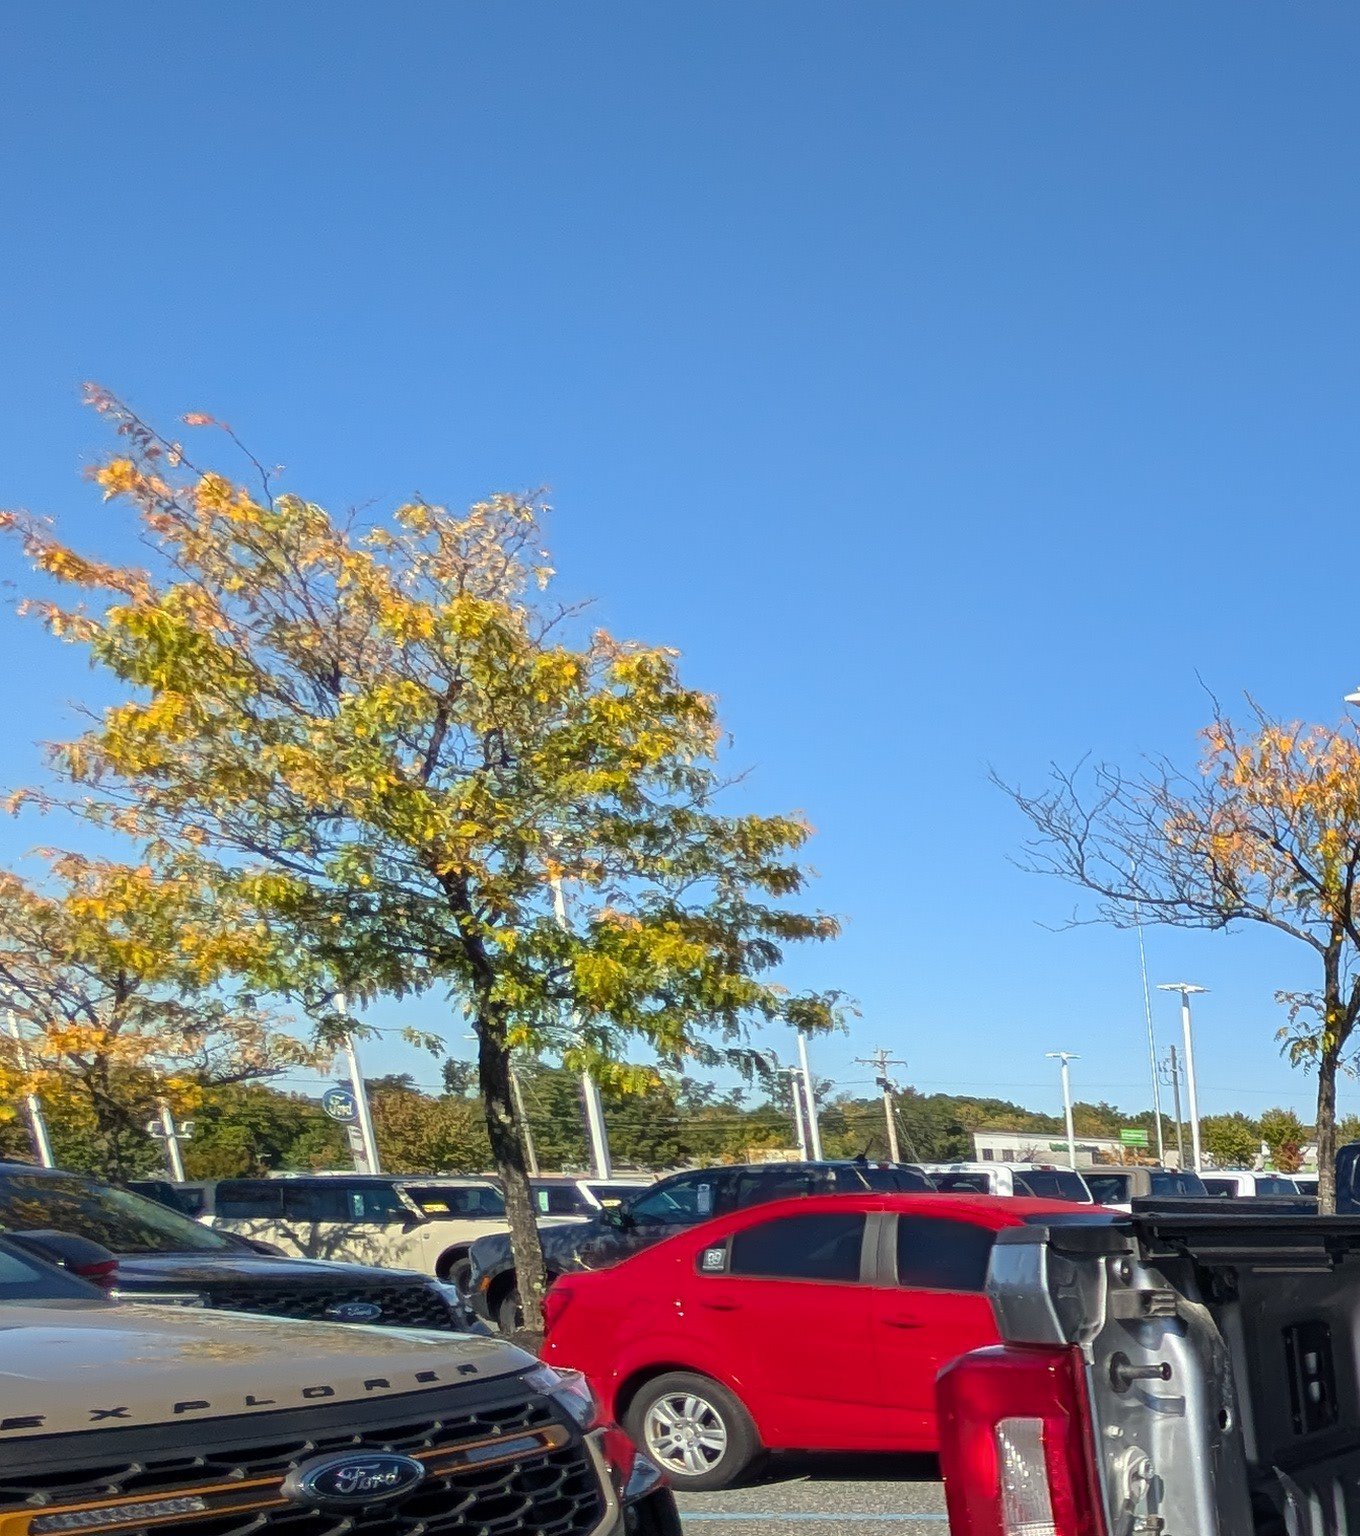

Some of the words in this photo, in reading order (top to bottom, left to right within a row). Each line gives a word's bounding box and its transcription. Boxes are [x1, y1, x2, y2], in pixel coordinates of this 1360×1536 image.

[329, 1095, 353, 1116] Ford
[0, 1363, 479, 1431] EXPLORER
[335, 1463, 401, 1494] Ford
